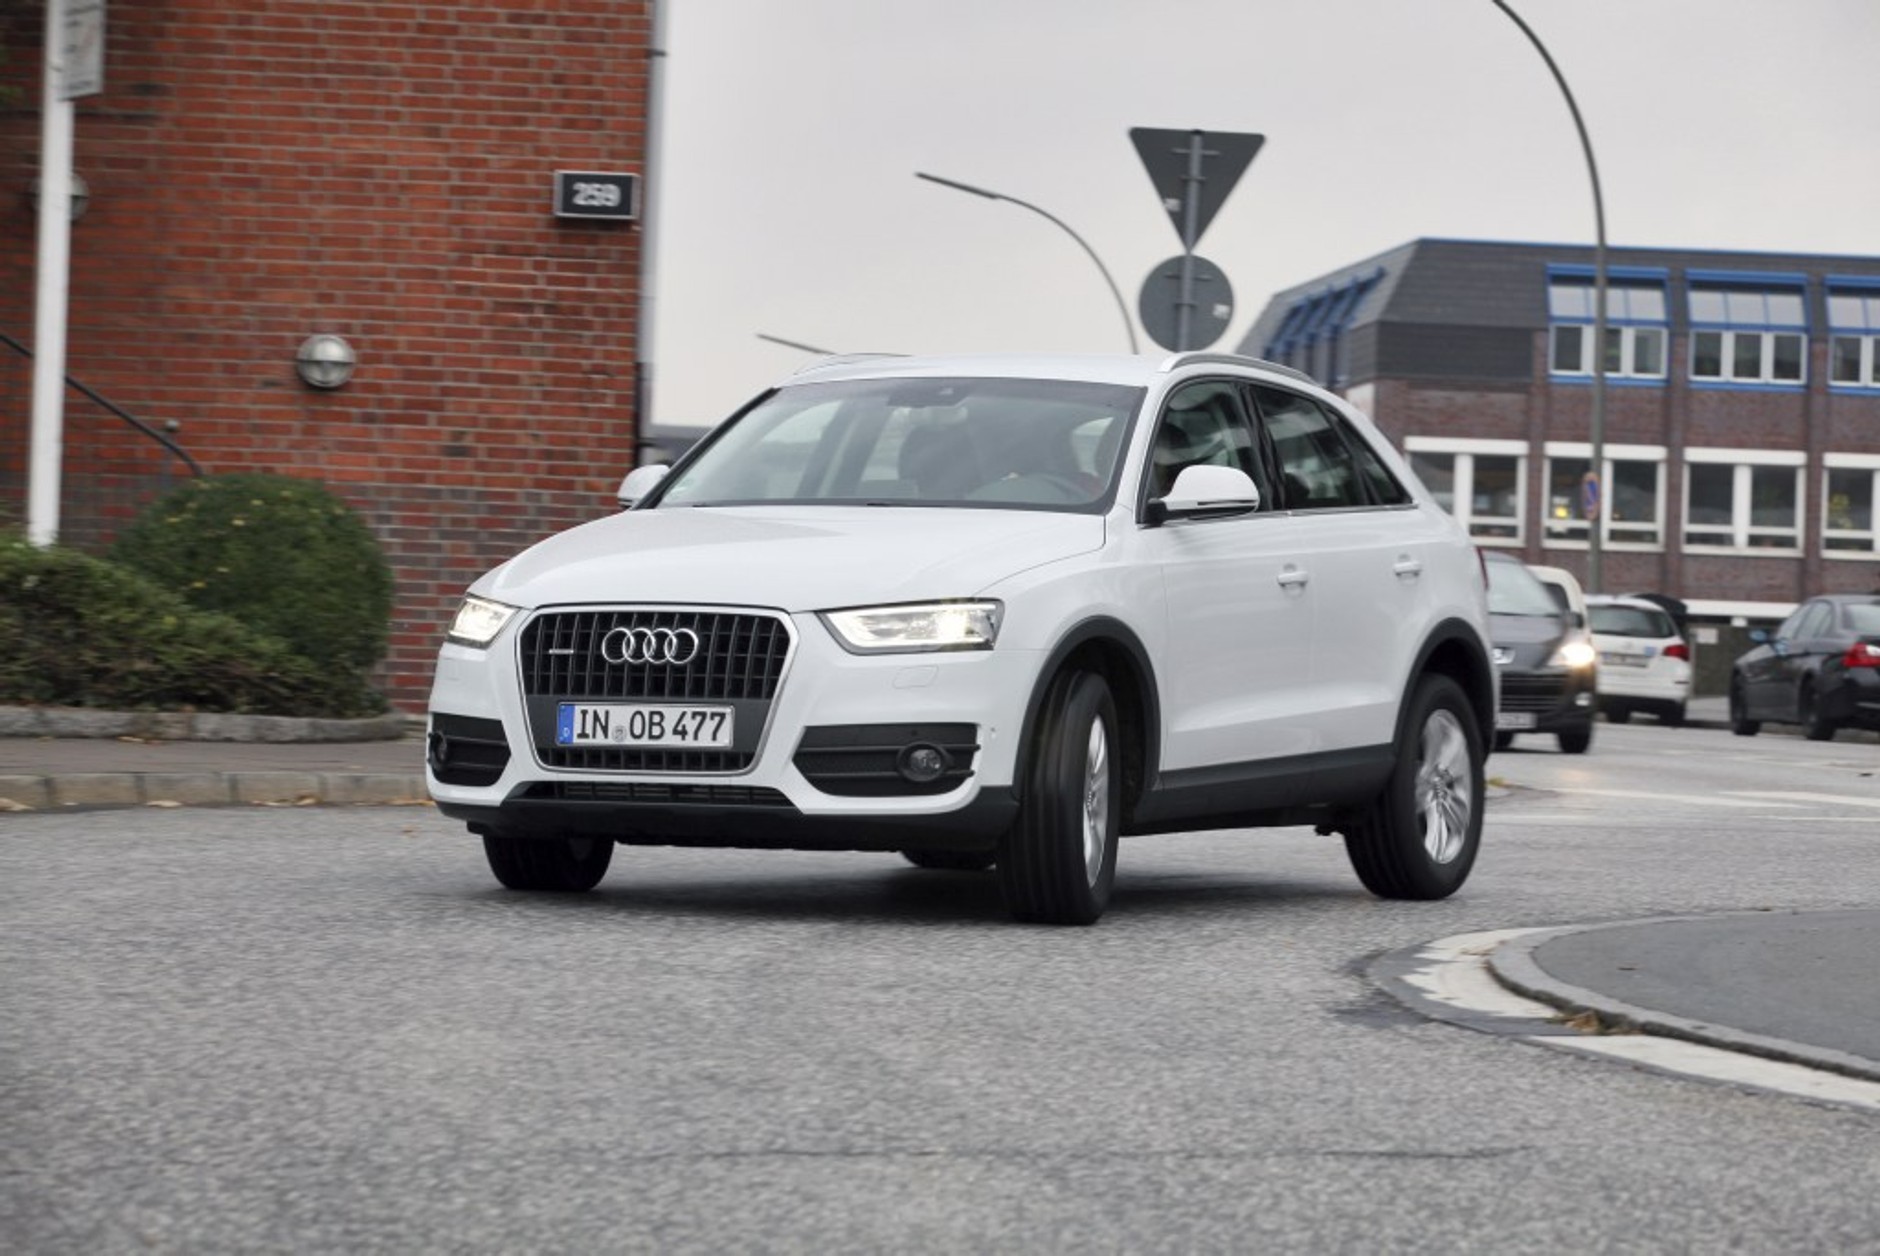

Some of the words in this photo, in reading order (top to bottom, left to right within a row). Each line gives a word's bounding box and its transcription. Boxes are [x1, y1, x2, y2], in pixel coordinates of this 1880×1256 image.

[572, 182, 621, 207] 259
[576, 709, 610, 739] IN
[629, 710, 666, 740] OB
[672, 711, 727, 741] 477
